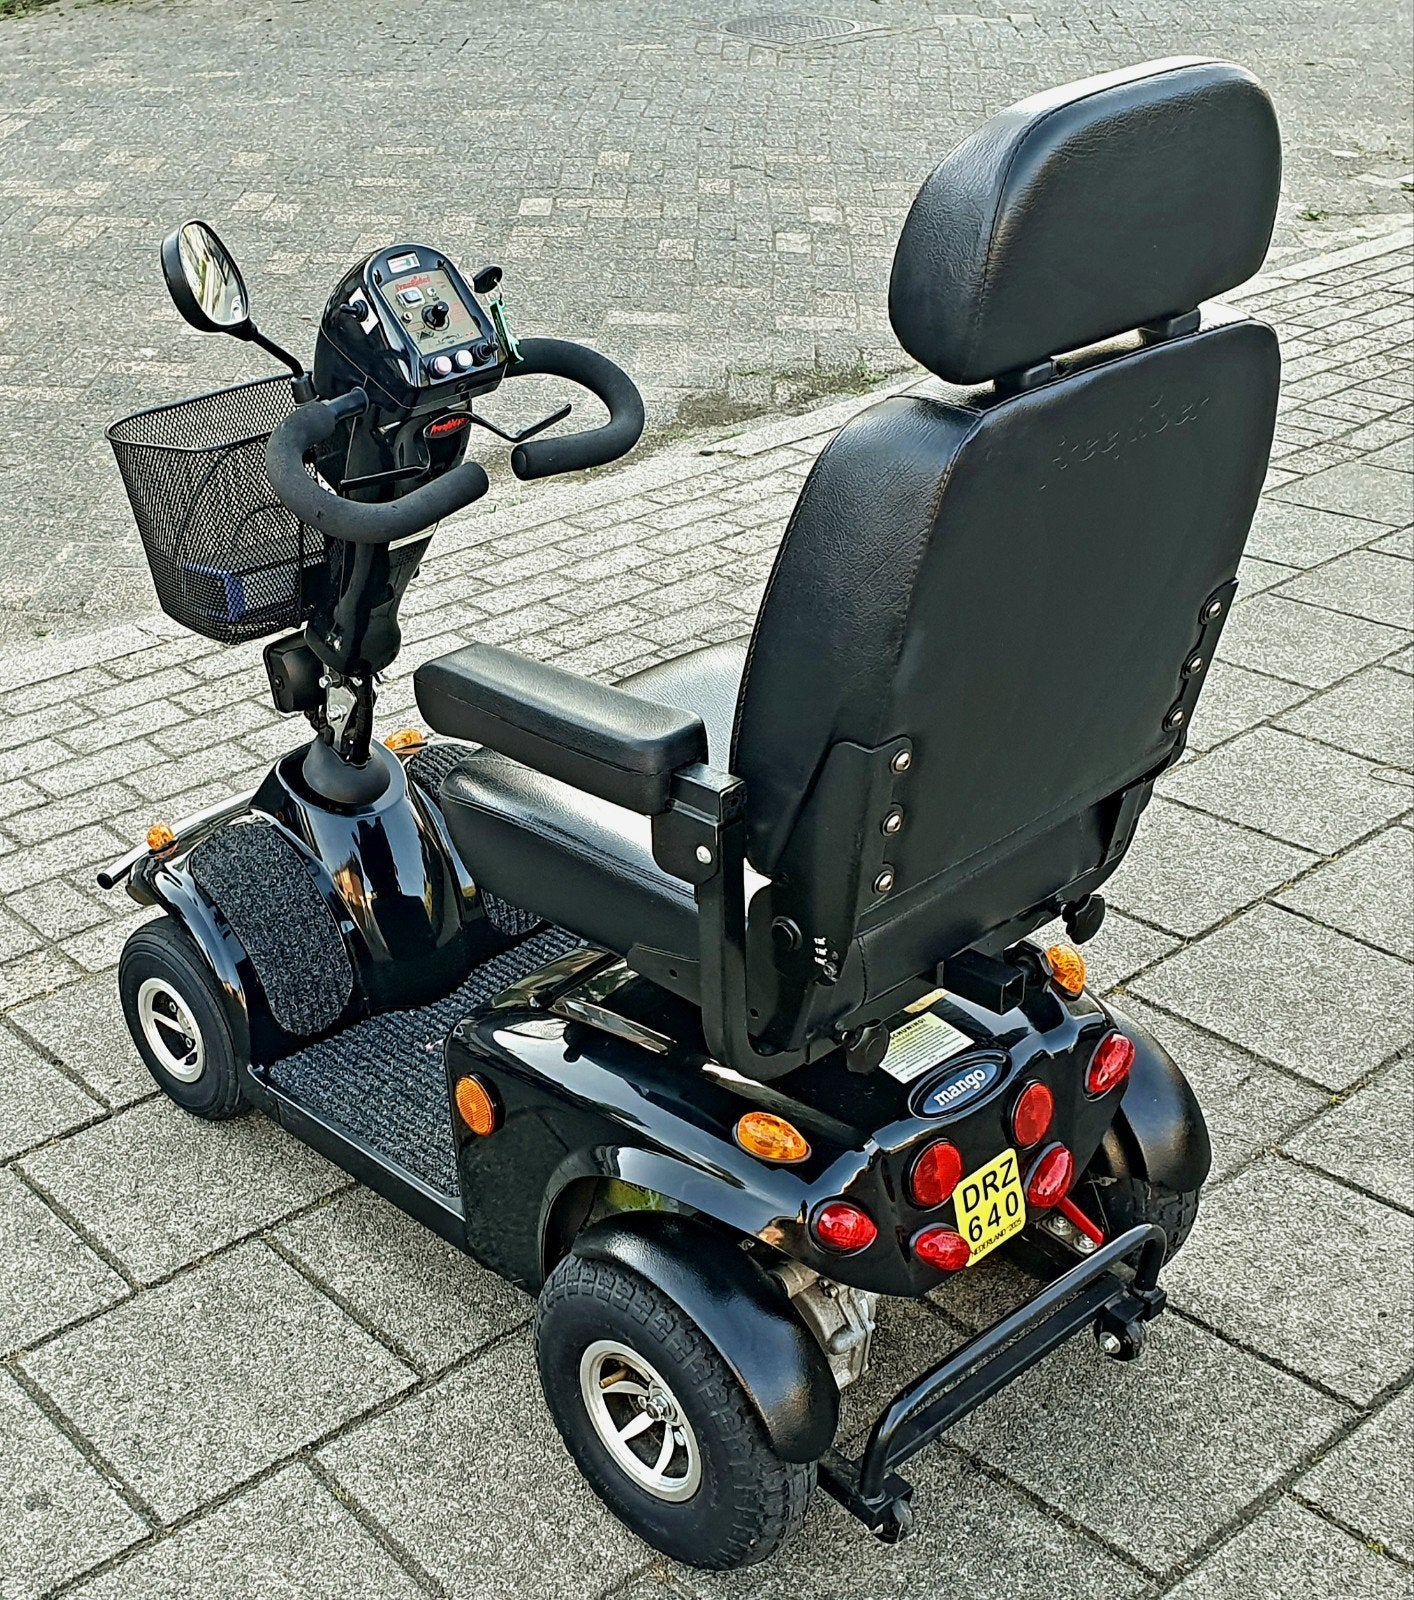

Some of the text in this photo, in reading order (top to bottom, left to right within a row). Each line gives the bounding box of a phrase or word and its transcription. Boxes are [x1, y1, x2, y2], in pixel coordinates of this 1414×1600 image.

[933, 1069, 986, 1106] mango
[962, 1157, 1017, 1213] DRZ
[968, 1191, 1019, 1243] 640
[971, 1228, 1007, 1257] NEDERLAND
